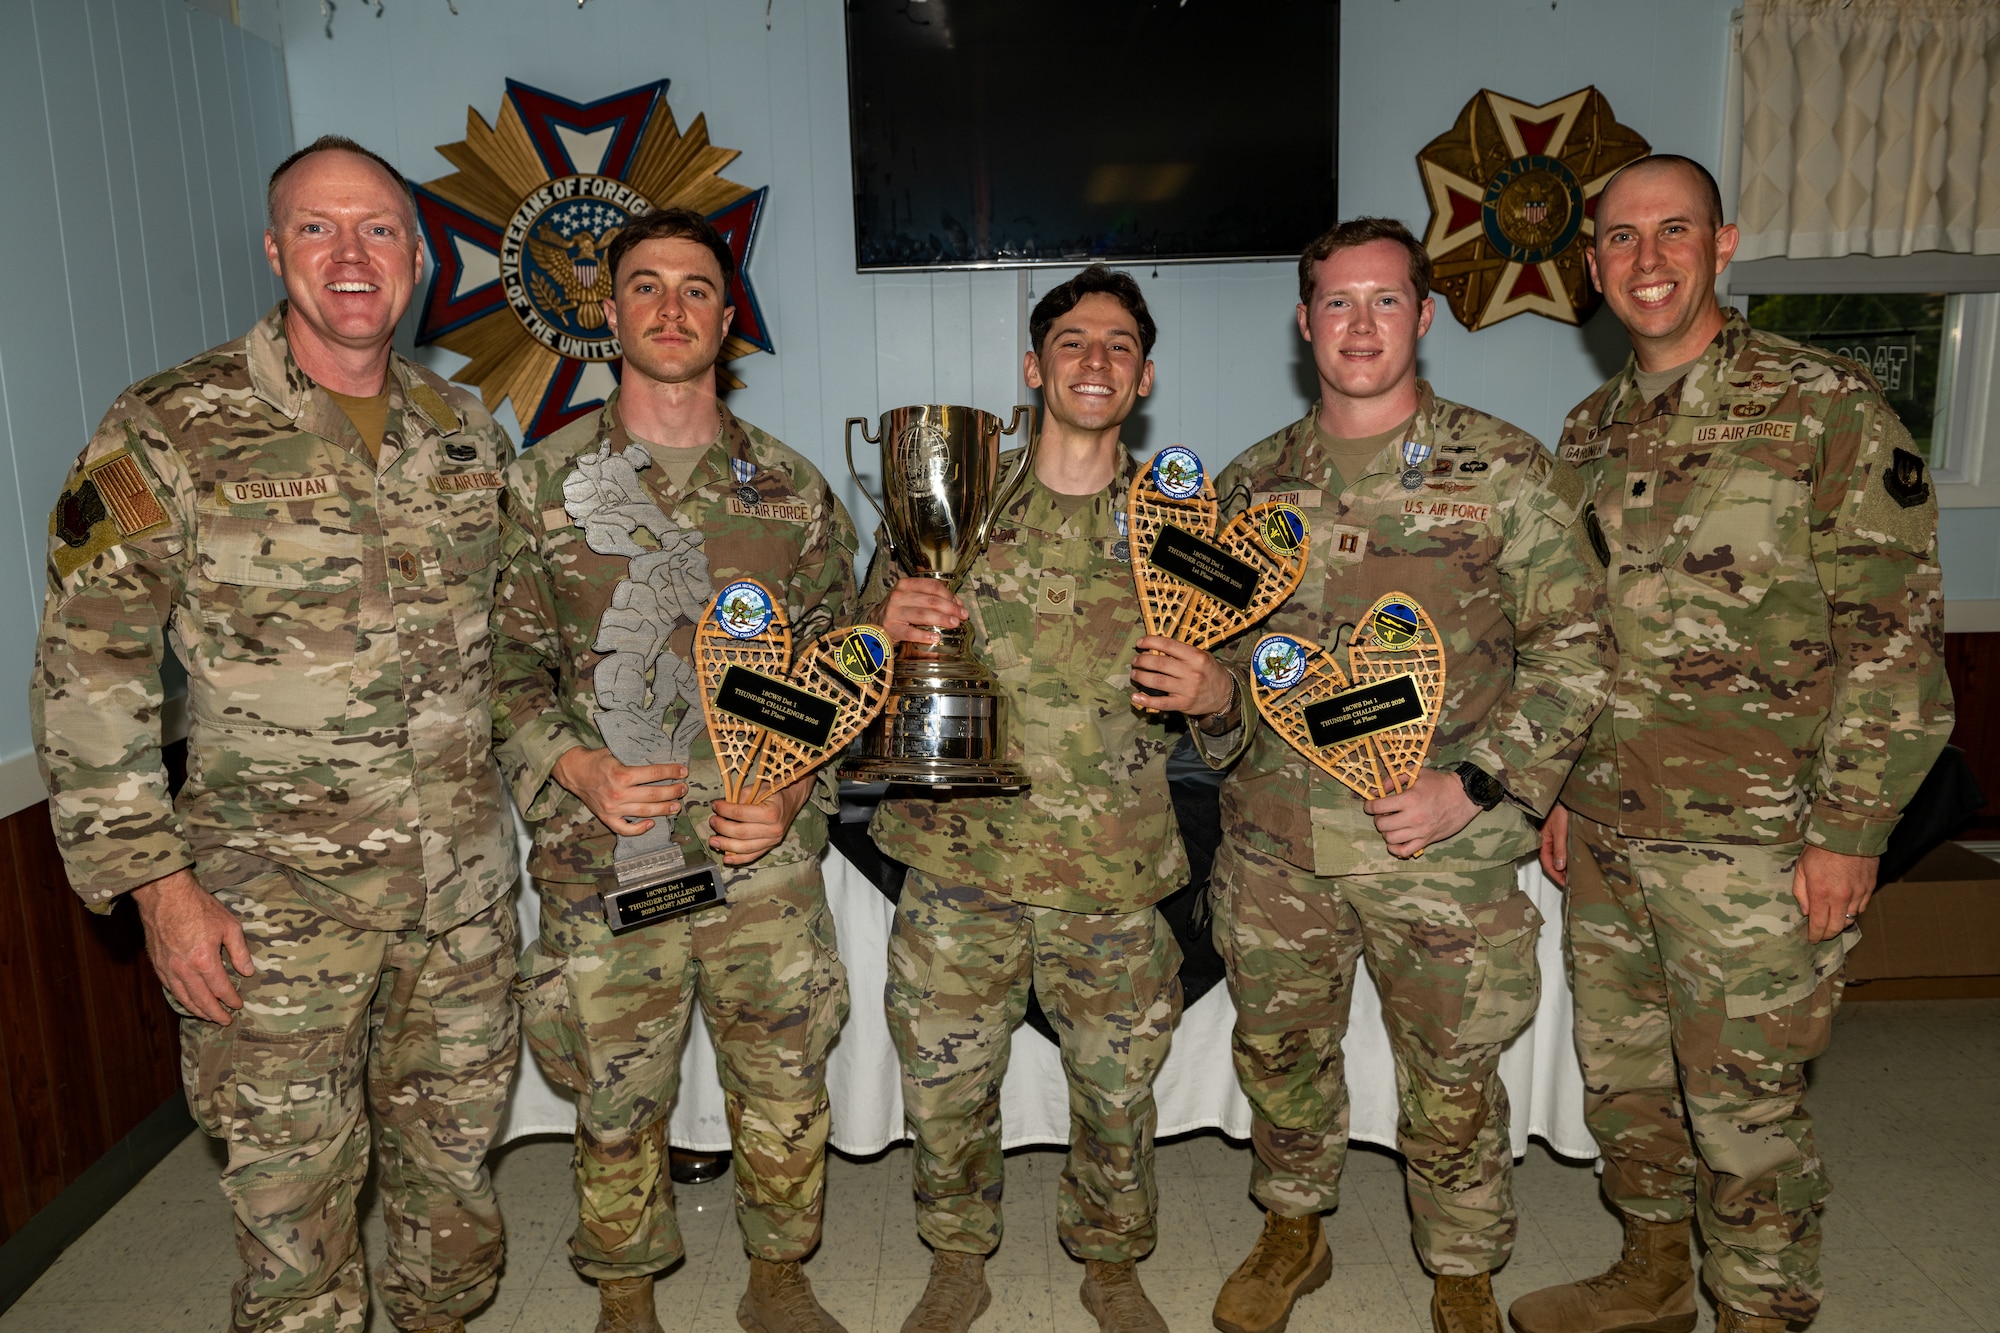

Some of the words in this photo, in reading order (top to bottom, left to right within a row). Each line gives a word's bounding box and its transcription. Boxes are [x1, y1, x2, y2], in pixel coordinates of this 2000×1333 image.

[502, 187, 553, 278] VETERANS
[553, 179, 577, 199] OF
[579, 177, 652, 217] FOREIG
[508, 286, 529, 308] OF
[523, 309, 557, 346] THE
[558, 335, 623, 358] UNITED
[1720, 427, 1745, 440] AIR
[1746, 422, 1793, 439] FORCE
[235, 478, 327, 500] O'SULLIVAN
[454, 475, 474, 490] AIR
[473, 472, 501, 488] FORCE
[1156, 480, 1174, 497] THUNDER
[1175, 484, 1200, 498] CHALLENGE
[1268, 493, 1299, 505] PETRI
[755, 504, 771, 517] AIR
[772, 505, 808, 520] FORCE
[1404, 500, 1425, 514] U.S.
[1429, 502, 1448, 515] AIR
[1451, 504, 1489, 521] FORCE
[990, 528, 1016, 542] ADA
[1168, 546, 1196, 565] THUNDER
[1196, 560, 1231, 583] CHALLENGE
[1192, 566, 1200, 575] 1st
[1200, 570, 1214, 582] Place
[720, 619, 740, 637] THUNDER
[740, 622, 767, 638] CHALLENGE
[1269, 681, 1292, 689] THUNDER
[1292, 657, 1306, 684] CHALLENGE
[761, 690, 781, 702] 18CWS
[782, 697, 793, 705] Det
[734, 688, 766, 705] THUNDER
[766, 700, 805, 720] CHALLENGE
[805, 716, 820, 726] 2026
[761, 707, 771, 715] 1st
[770, 711, 786, 721] Place
[1320, 713, 1353, 728] THUNDER
[1352, 701, 1391, 718] CHALLENGE
[1391, 697, 1406, 707] 2026
[1342, 701, 1363, 713] 18CWS
[1362, 714, 1378, 723] Place
[628, 897, 664, 912] THUNDER
[663, 884, 705, 902] CHALLENGE
[646, 886, 668, 899] 18CWS
[668, 884, 680, 892] Det
[641, 908, 656, 916] 2026
[656, 901, 676, 912] MOST
[676, 895, 696, 907] ARMY
